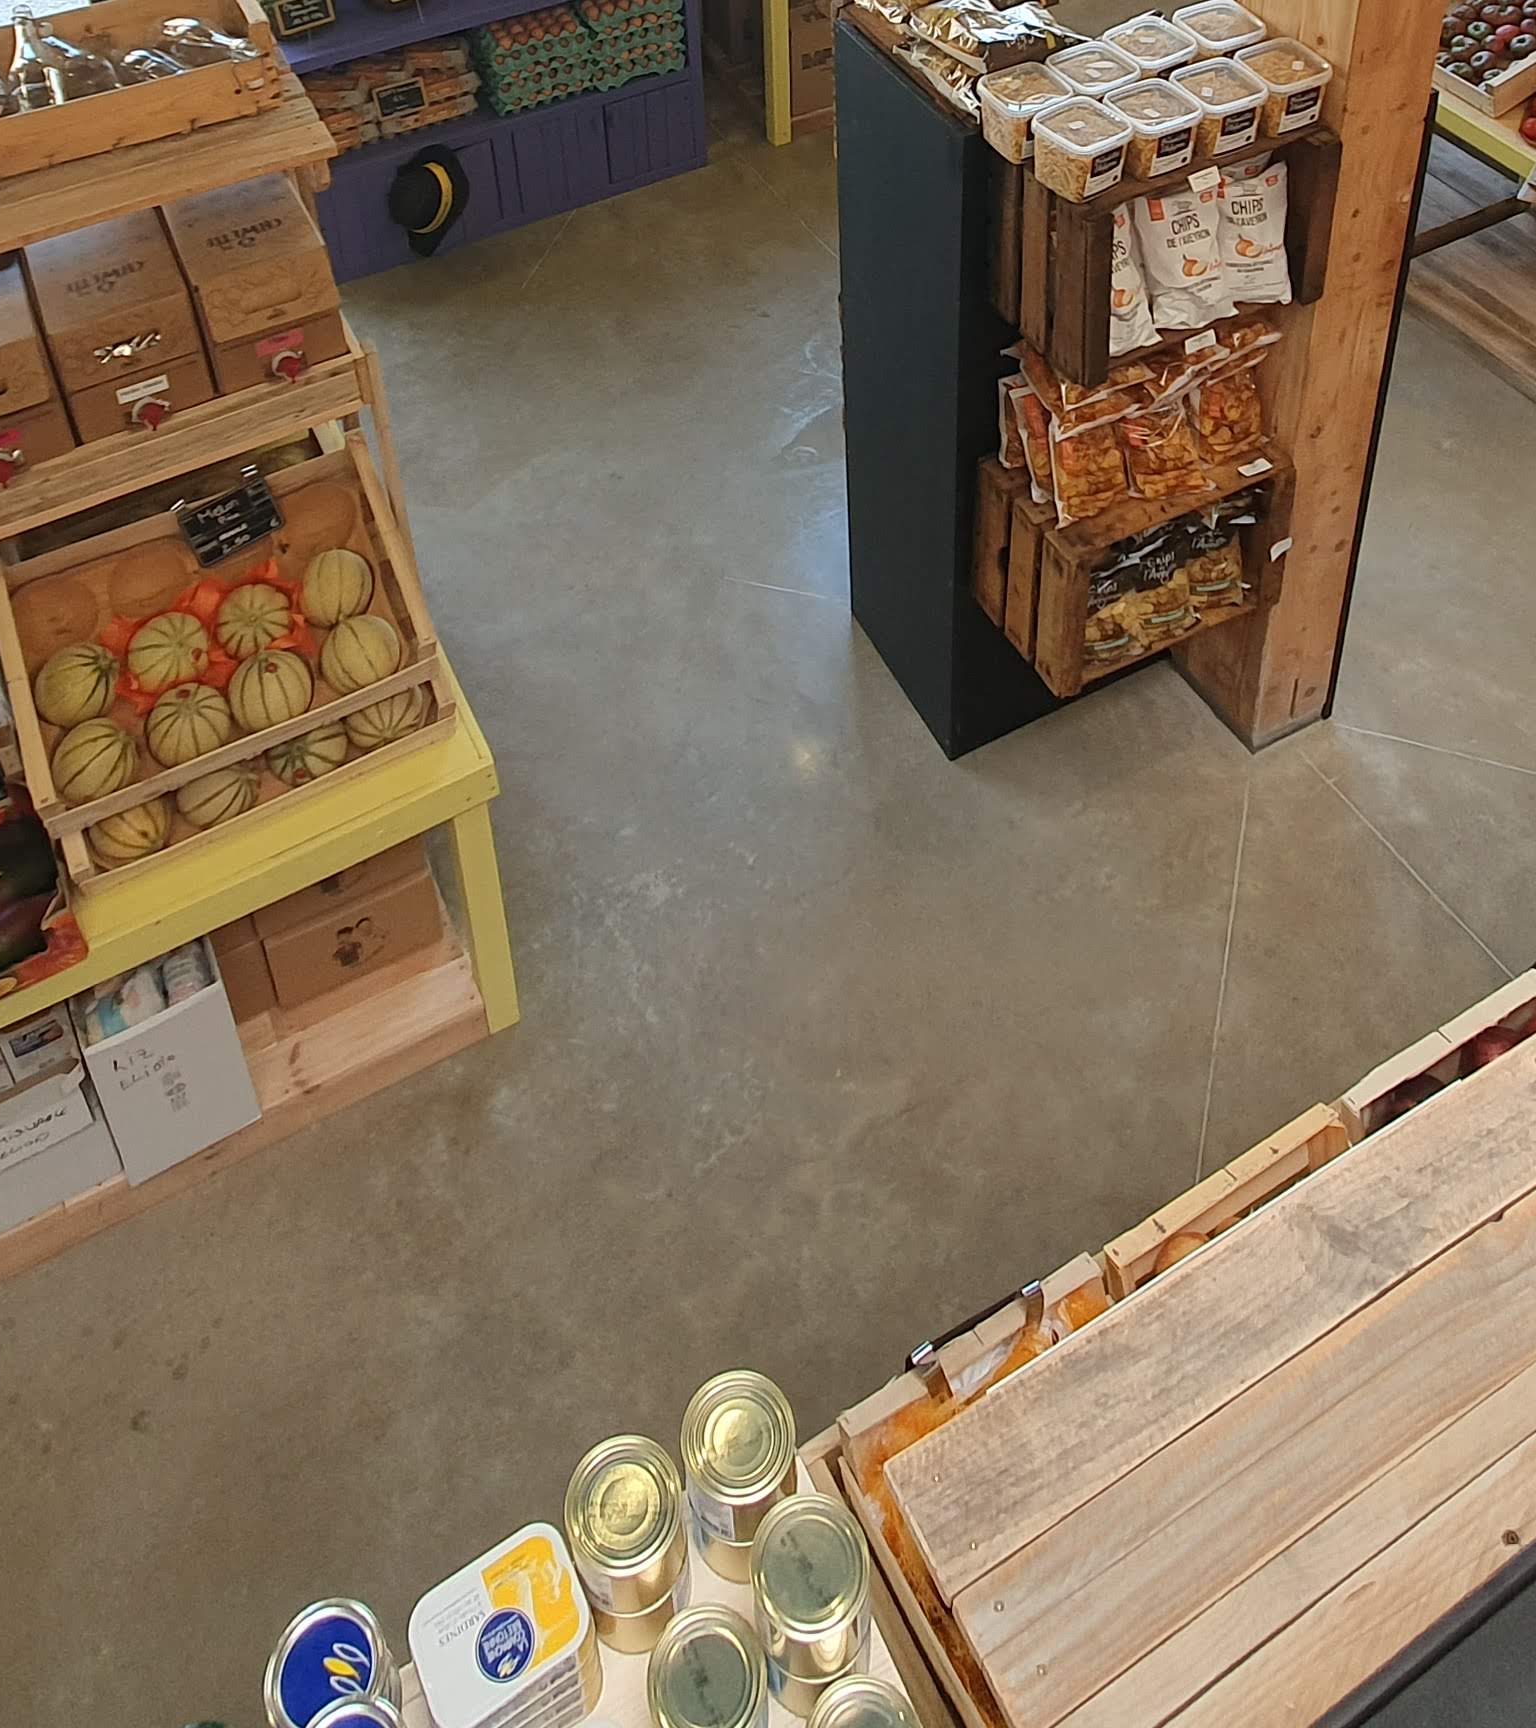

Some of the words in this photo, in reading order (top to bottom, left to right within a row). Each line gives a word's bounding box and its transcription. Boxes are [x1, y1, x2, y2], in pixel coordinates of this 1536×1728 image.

[1231, 197, 1265, 216] CHIPS
[1171, 212, 1201, 236] CHIPS
[437, 1610, 486, 1648] SARDINES
